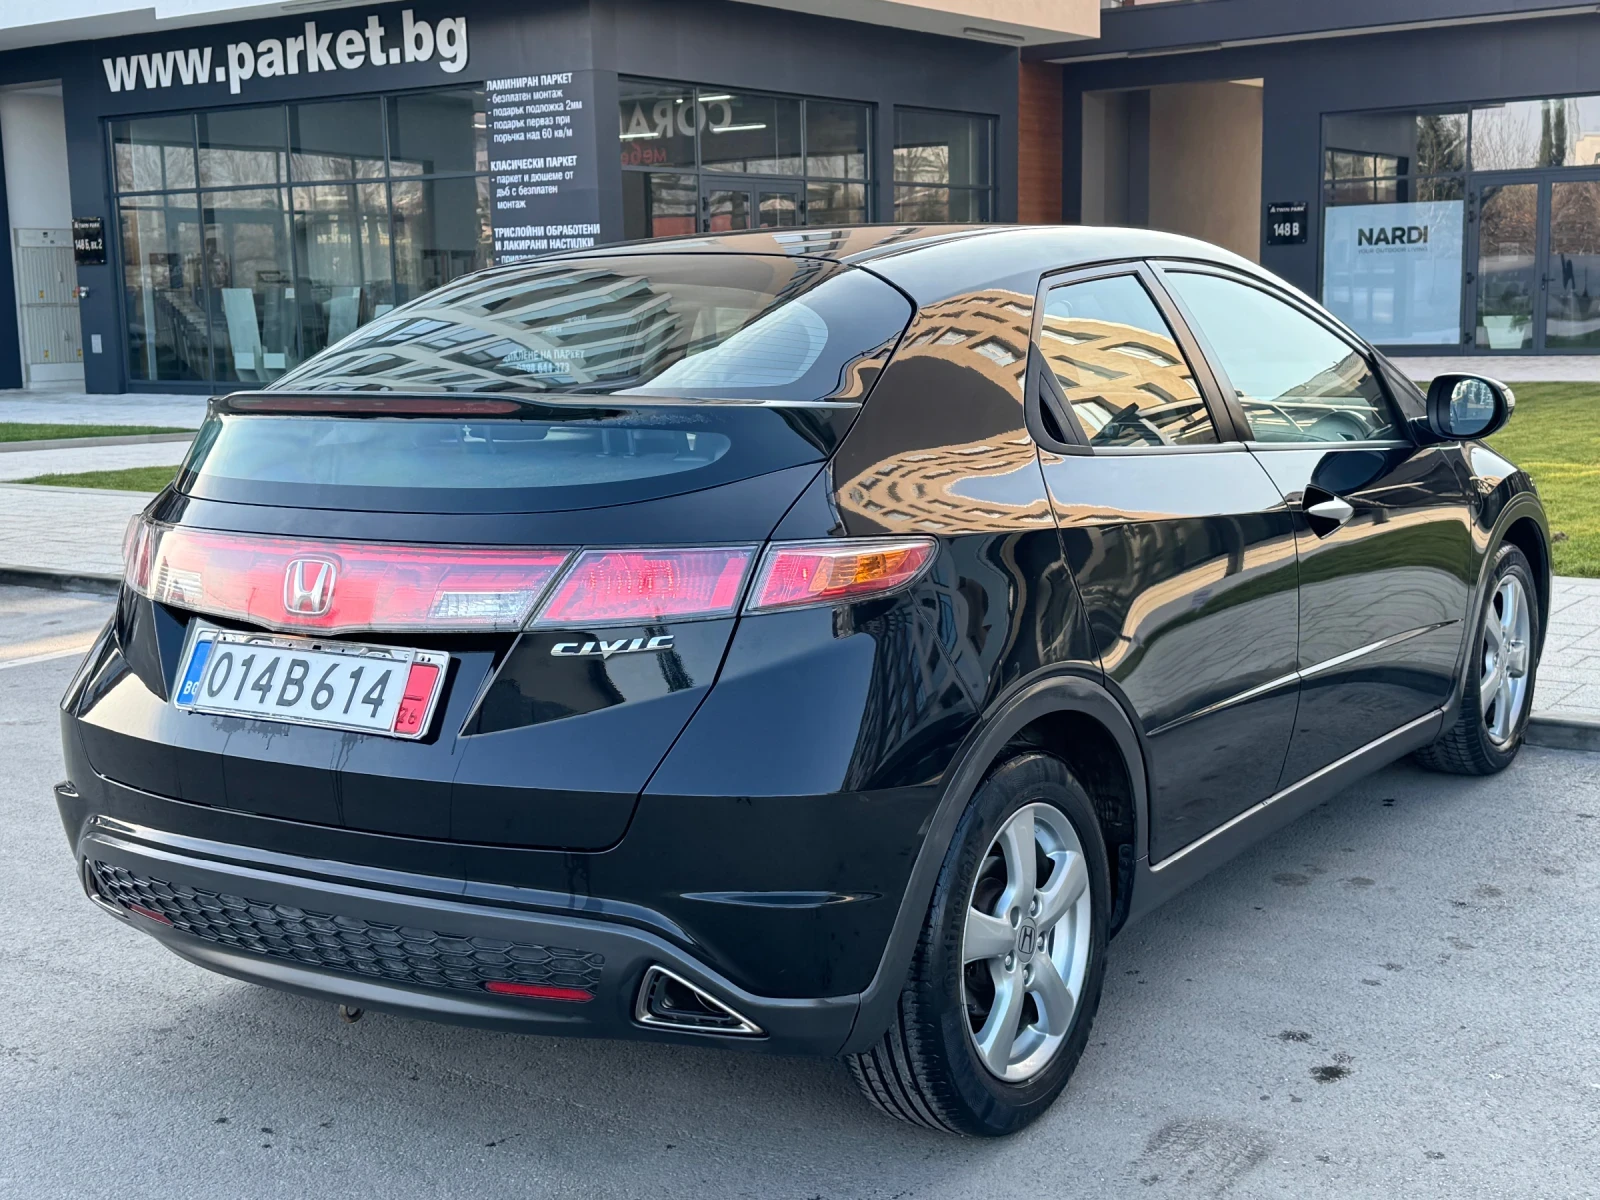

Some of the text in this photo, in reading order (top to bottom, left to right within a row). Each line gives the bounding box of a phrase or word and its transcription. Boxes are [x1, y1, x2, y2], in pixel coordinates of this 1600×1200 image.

[102, 9, 466, 94] www.parket.bg
[486, 72, 573, 91] ЛАМИНИРАН ПАРКЕТ
[492, 89, 563, 104] безплатен монтаж
[526, 101, 564, 114] подложка
[565, 99, 582, 110] 2мм
[526, 117, 553, 129] перваз
[555, 115, 570, 127] при
[526, 130, 541, 140] над
[541, 128, 552, 139] 60
[554, 126, 572, 139] кв/м
[490, 155, 577, 171] КЛАСИЧЕСКИ ПАРКЕТ
[496, 171, 574, 185] паркет и дюшеме от
[518, 185, 558, 196] безплатен
[497, 200, 526, 209] монтаж
[494, 223, 600, 238] ТРИСЛОЙНИ ОБРАБОТЕНИ
[1273, 223, 1291, 236] 148
[1358, 225, 1428, 246] NARDI
[495, 237, 594, 251] И ЛАКИРАНИ НАСТИЛКИ
[554, 349, 586, 360] ПАРКЕТ
[550, 635, 675, 659] CIVIC
[206, 651, 393, 719] 014B614
